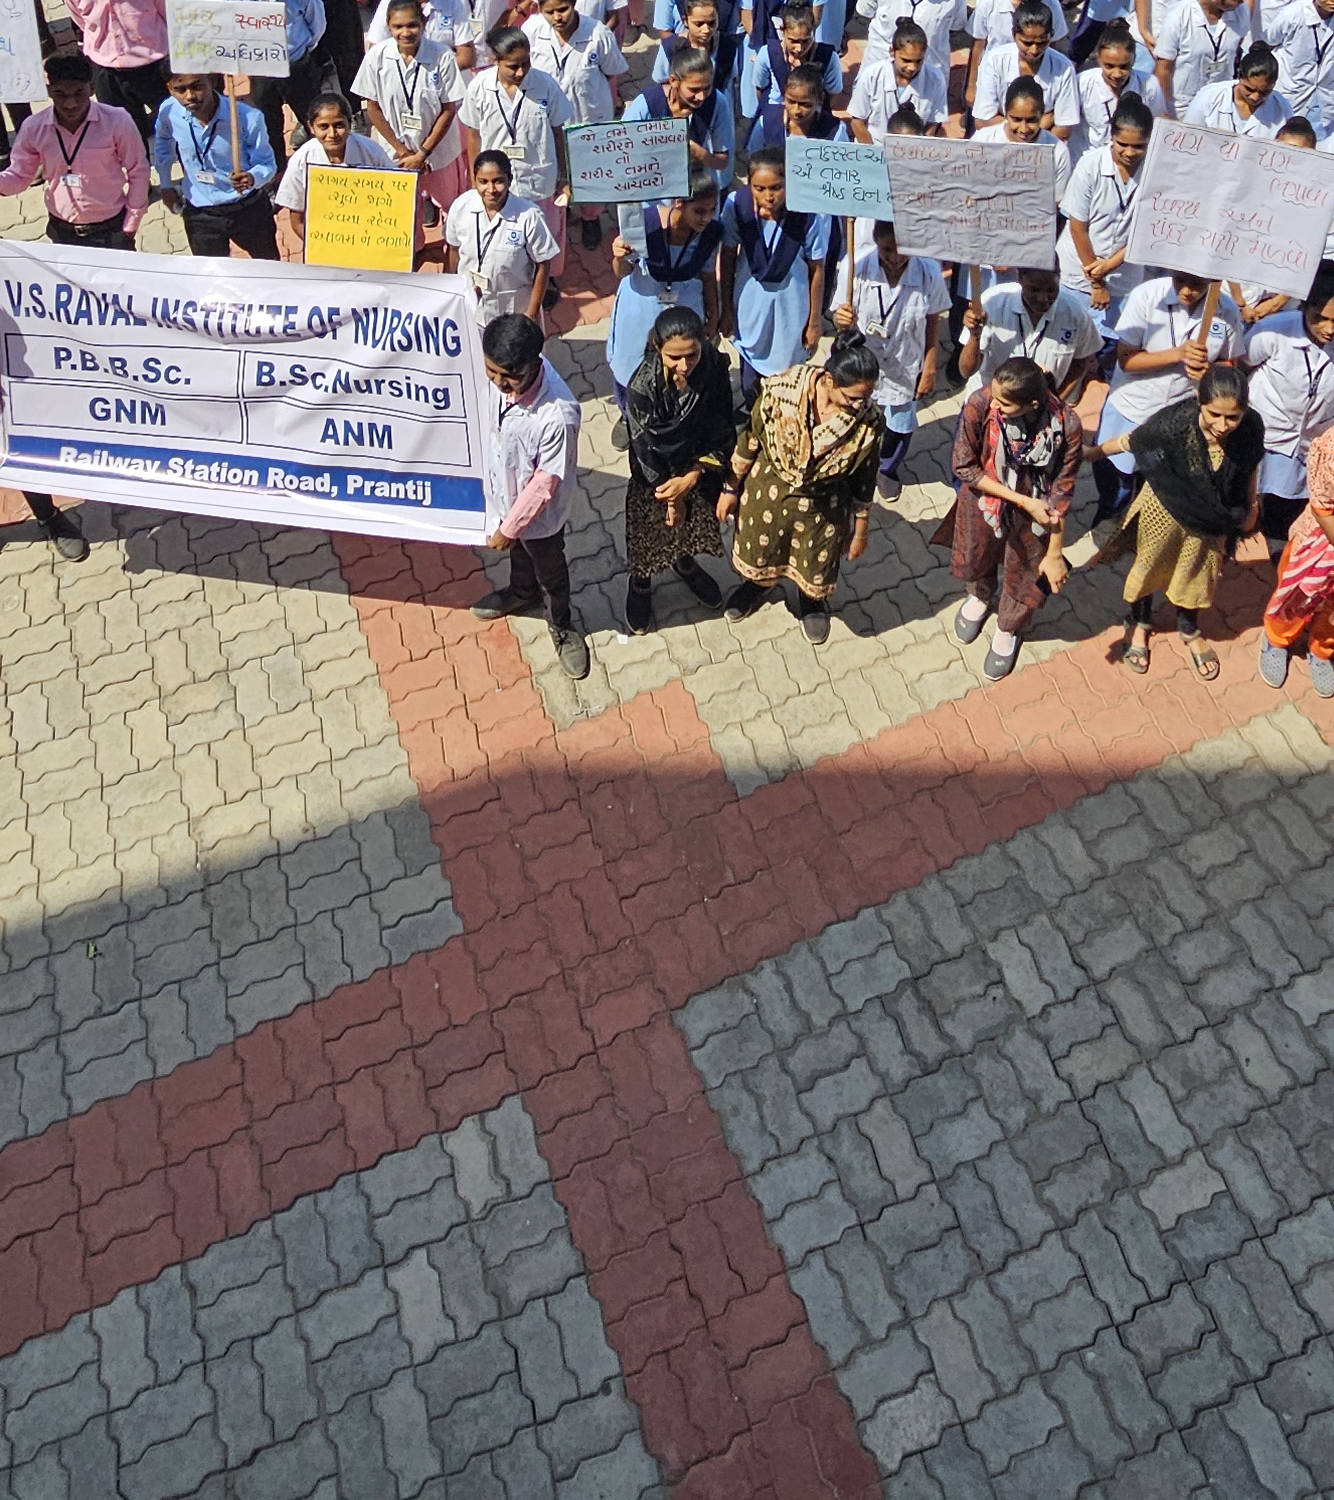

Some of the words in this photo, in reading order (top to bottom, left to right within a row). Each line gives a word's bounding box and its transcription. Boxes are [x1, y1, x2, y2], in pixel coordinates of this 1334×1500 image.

[625, 157, 660, 176] તમને
[4, 280, 148, 327] V.S.RAVAL
[152, 296, 302, 338] INSTITUTE
[307, 305, 342, 340] OF
[351, 307, 463, 357] NURSING
[53, 346, 192, 386] P.B.B.Sc.
[88, 396, 167, 426] GNM
[319, 417, 393, 450] ANM
[59, 446, 162, 475] Railway
[167, 457, 259, 486] Station
[267, 466, 338, 498] Road,
[346, 474, 433, 506] Prantij
